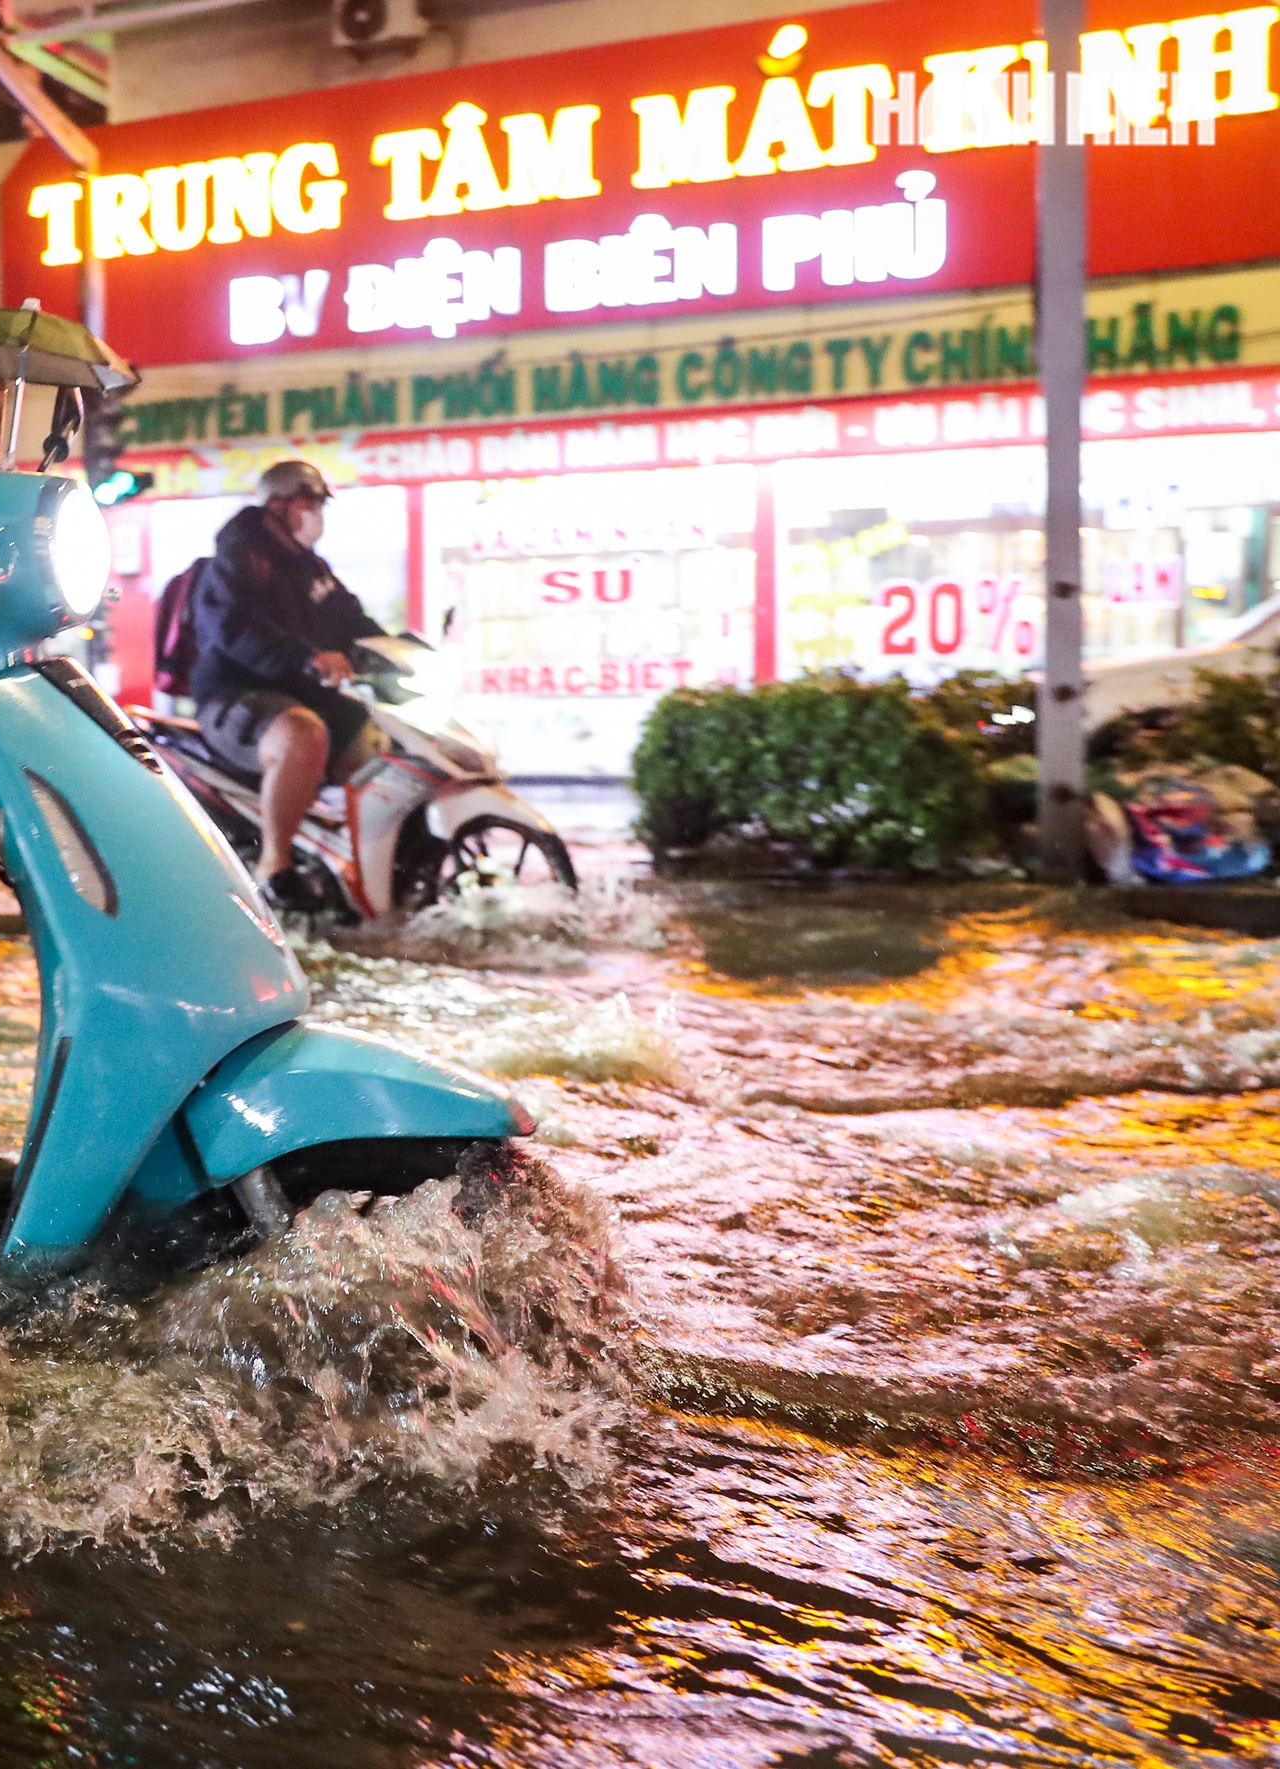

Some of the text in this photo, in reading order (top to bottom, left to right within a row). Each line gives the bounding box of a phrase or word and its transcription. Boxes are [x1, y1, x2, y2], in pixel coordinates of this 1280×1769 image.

[28, 142, 347, 267] TRUNG
[371, 102, 602, 220] TÂM
[630, 23, 897, 189] MẮT
[228, 169, 947, 345] BV ĐIỆN BIÊN PHỦ
[675, 336, 813, 402] CÔNG
[825, 335, 892, 392] TY
[902, 314, 1040, 386] CHÍN
[880, 577, 1037, 656] 20%
